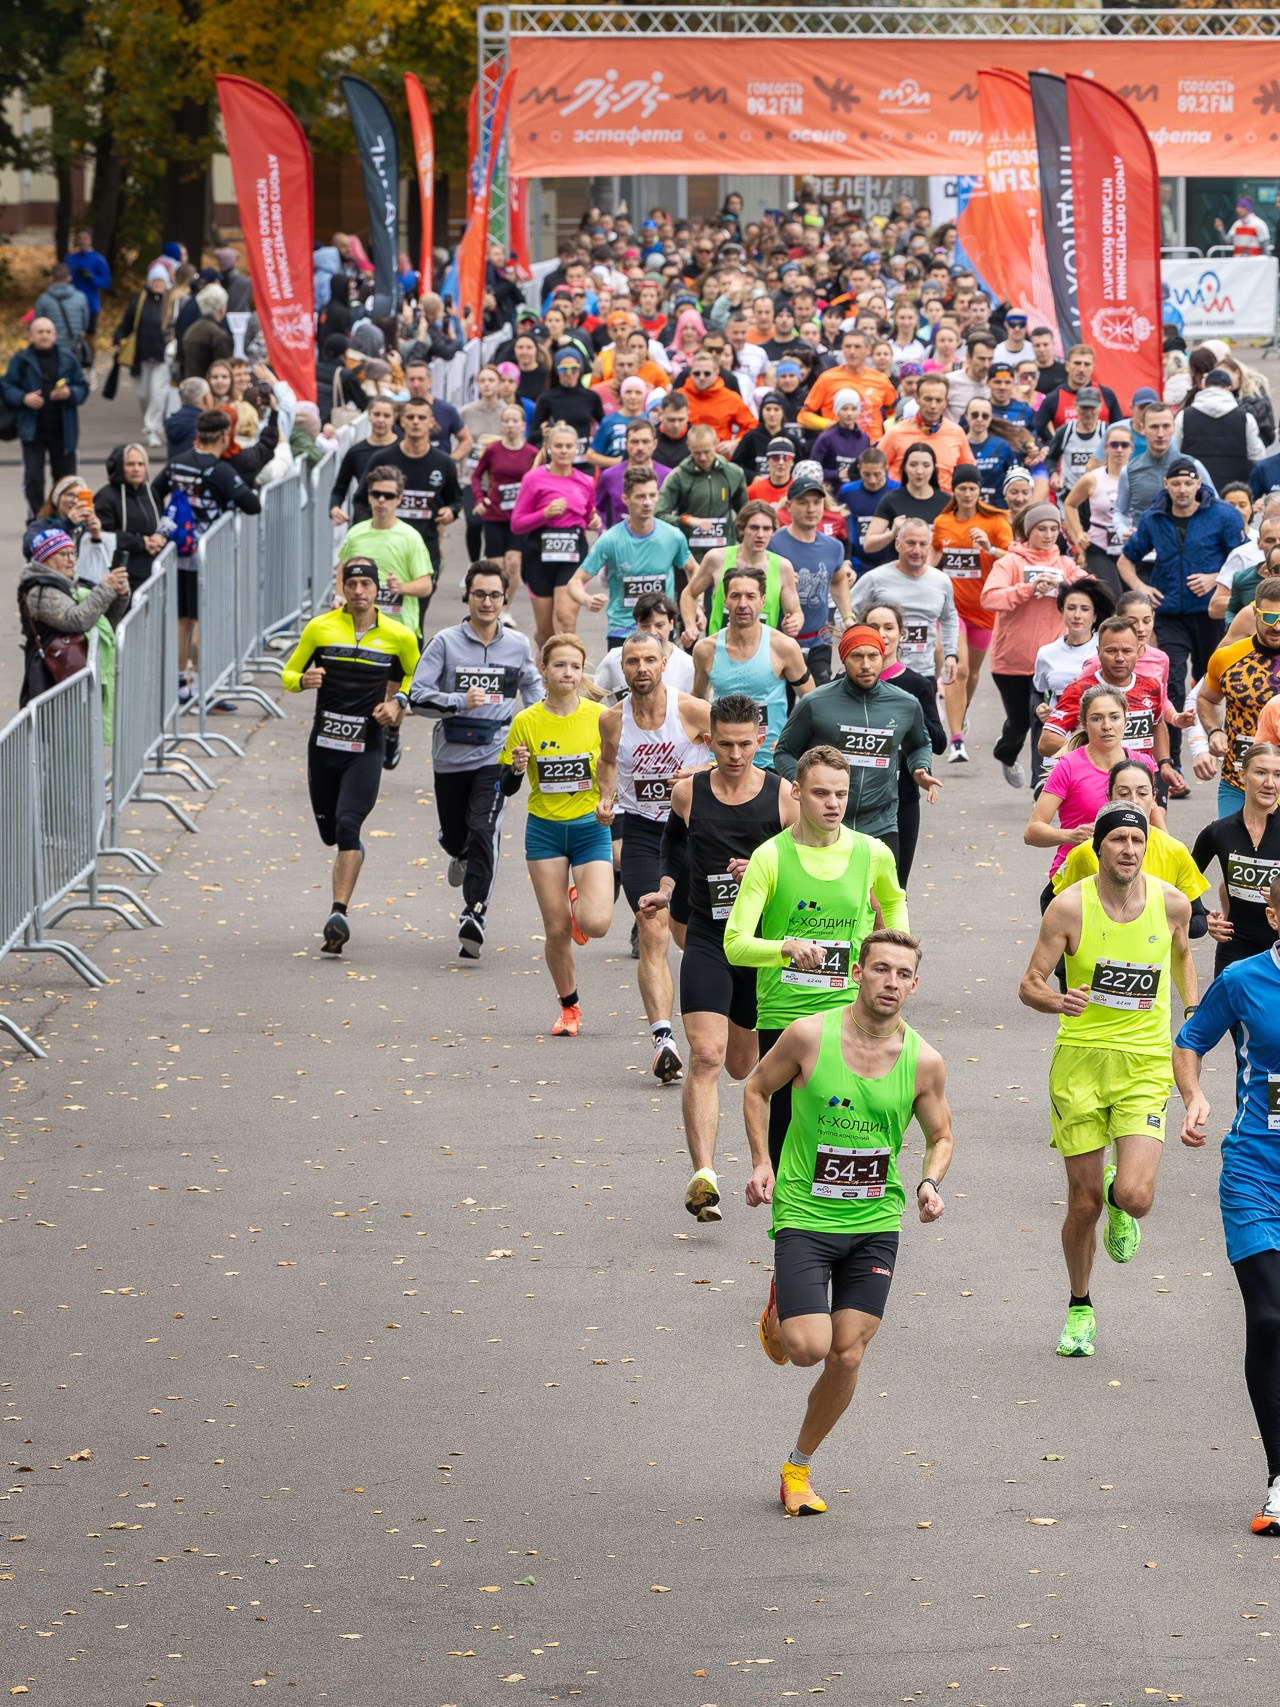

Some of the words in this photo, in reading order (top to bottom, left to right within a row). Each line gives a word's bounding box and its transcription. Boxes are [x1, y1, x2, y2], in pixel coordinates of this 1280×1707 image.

[572, 125, 683, 147] эстафета
[788, 129, 847, 143] осень
[948, 129, 984, 147] ту
[1148, 126, 1212, 147] афета
[693, 524, 725, 538] 245
[545, 538, 576, 553] 2073
[947, 555, 977, 568] 24-1
[629, 580, 663, 594] 2106
[459, 675, 500, 692] 2094
[323, 720, 363, 740] 2207
[1125, 718, 1150, 735] 273
[845, 734, 888, 755] 2187
[544, 762, 585, 778] 2223
[641, 783, 672, 800] 49-
[1232, 865, 1280, 886] 2078
[717, 884, 738, 900] 22
[788, 917, 858, 929] К-ХОЛДИНГ
[1099, 969, 1154, 992] 2270
[823, 1159, 880, 1181] 54-1
